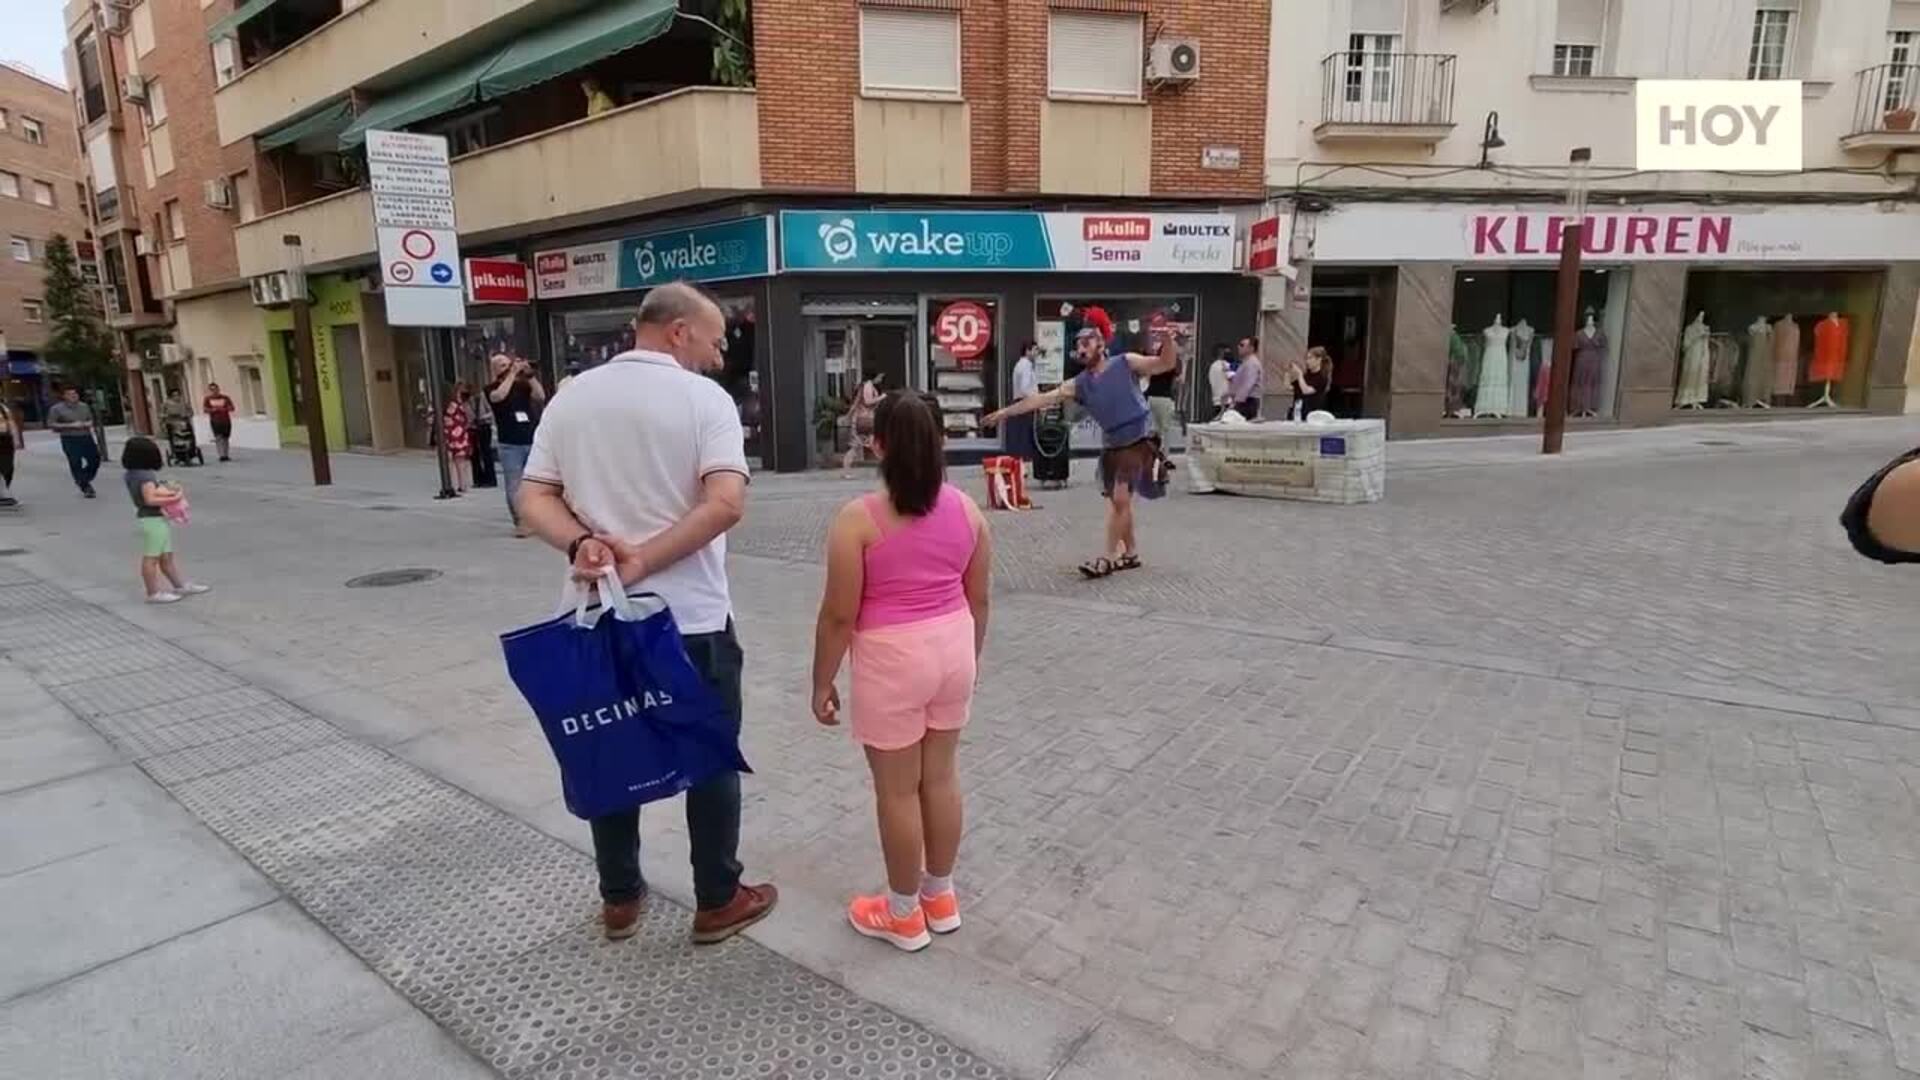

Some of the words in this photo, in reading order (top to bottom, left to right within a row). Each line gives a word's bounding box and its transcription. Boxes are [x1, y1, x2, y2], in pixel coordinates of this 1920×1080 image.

[1088, 220, 1145, 239] pikolin
[1178, 225, 1231, 236] BULTEX
[1473, 215, 1732, 254] KLEUREN
[1091, 246, 1141, 261] Sema
[473, 272, 525, 289] pikolin
